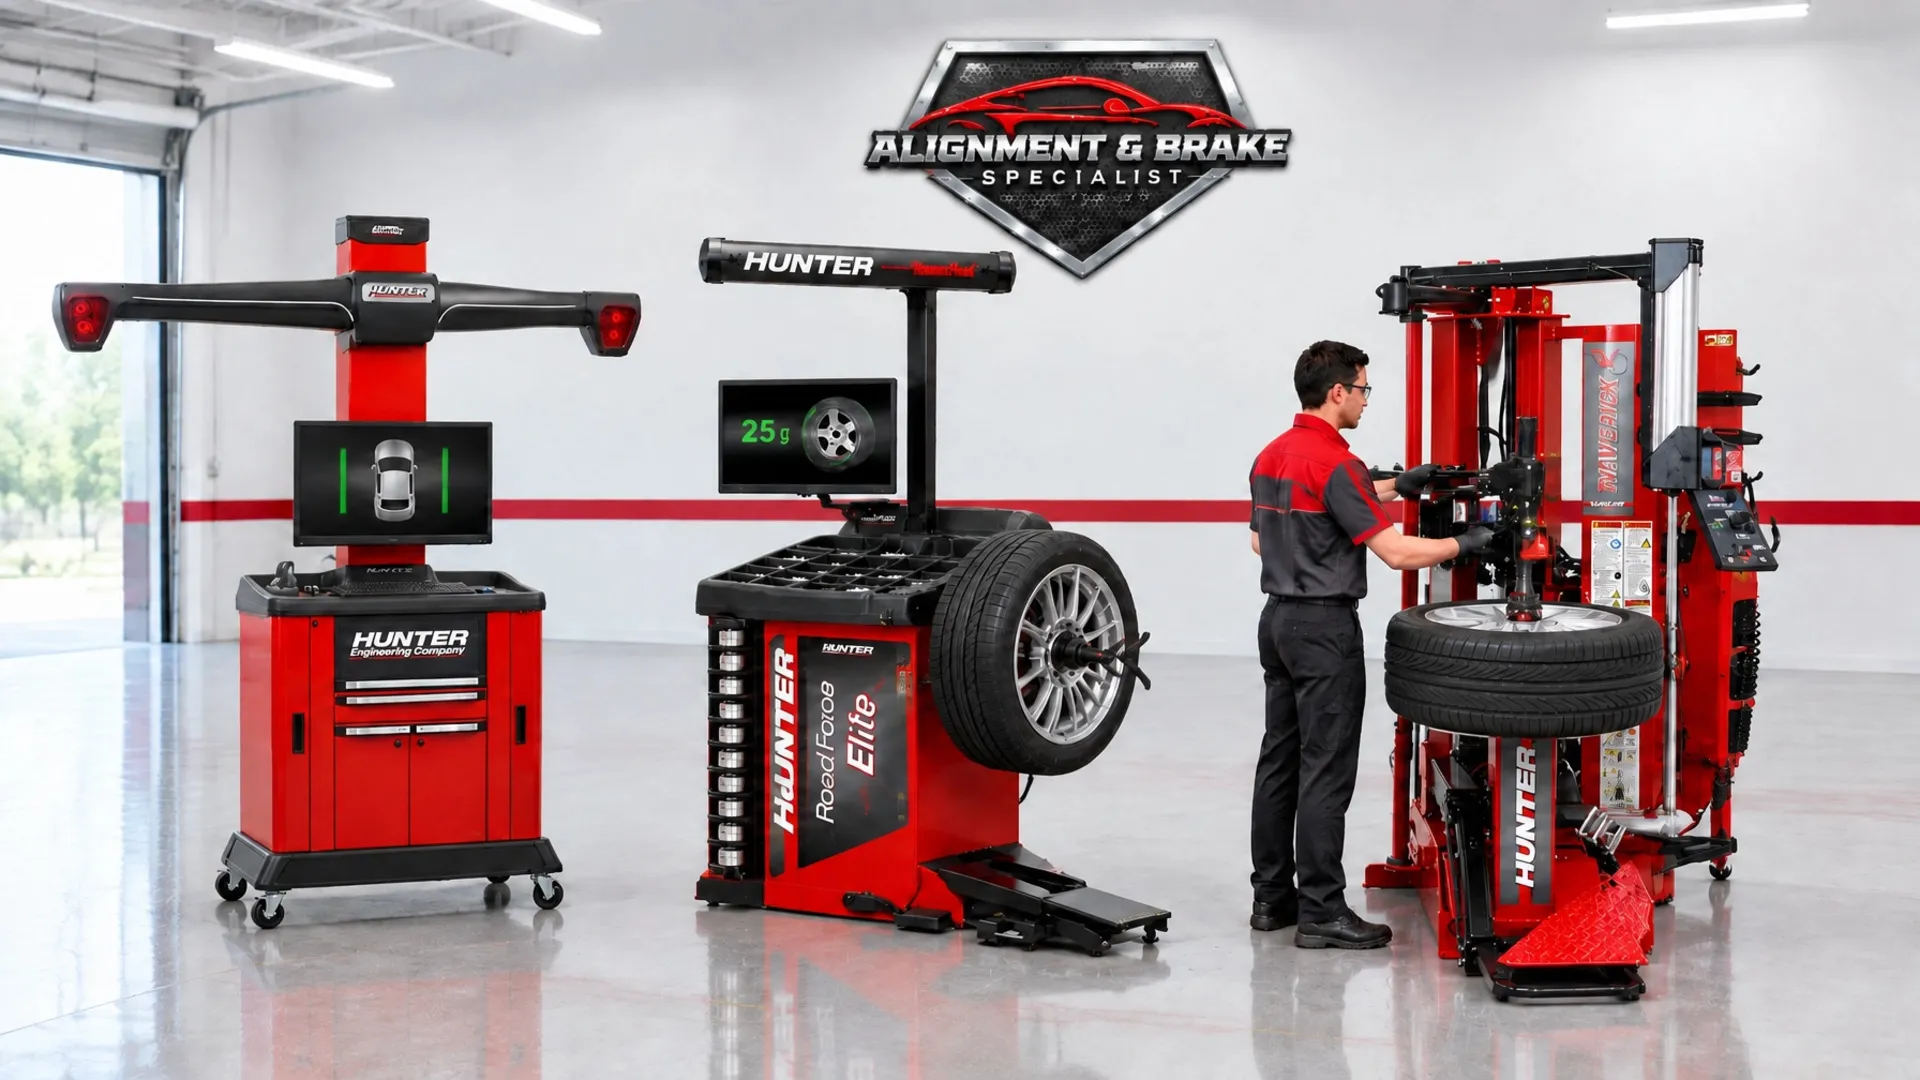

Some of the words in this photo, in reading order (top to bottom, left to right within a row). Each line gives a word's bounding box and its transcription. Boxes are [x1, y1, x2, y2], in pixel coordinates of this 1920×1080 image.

[868, 134, 1107, 162] ALIGNMENT
[1115, 134, 1143, 161] &
[1153, 134, 1289, 161] BRAKE
[982, 169, 1182, 185] SPECIALIST
[743, 251, 874, 276] HUNTER
[741, 419, 776, 443] 25
[780, 427, 790, 444] g
[352, 629, 469, 648] HUNTER
[822, 643, 874, 655] HUNTER
[1515, 745, 1537, 888] HUNTER
